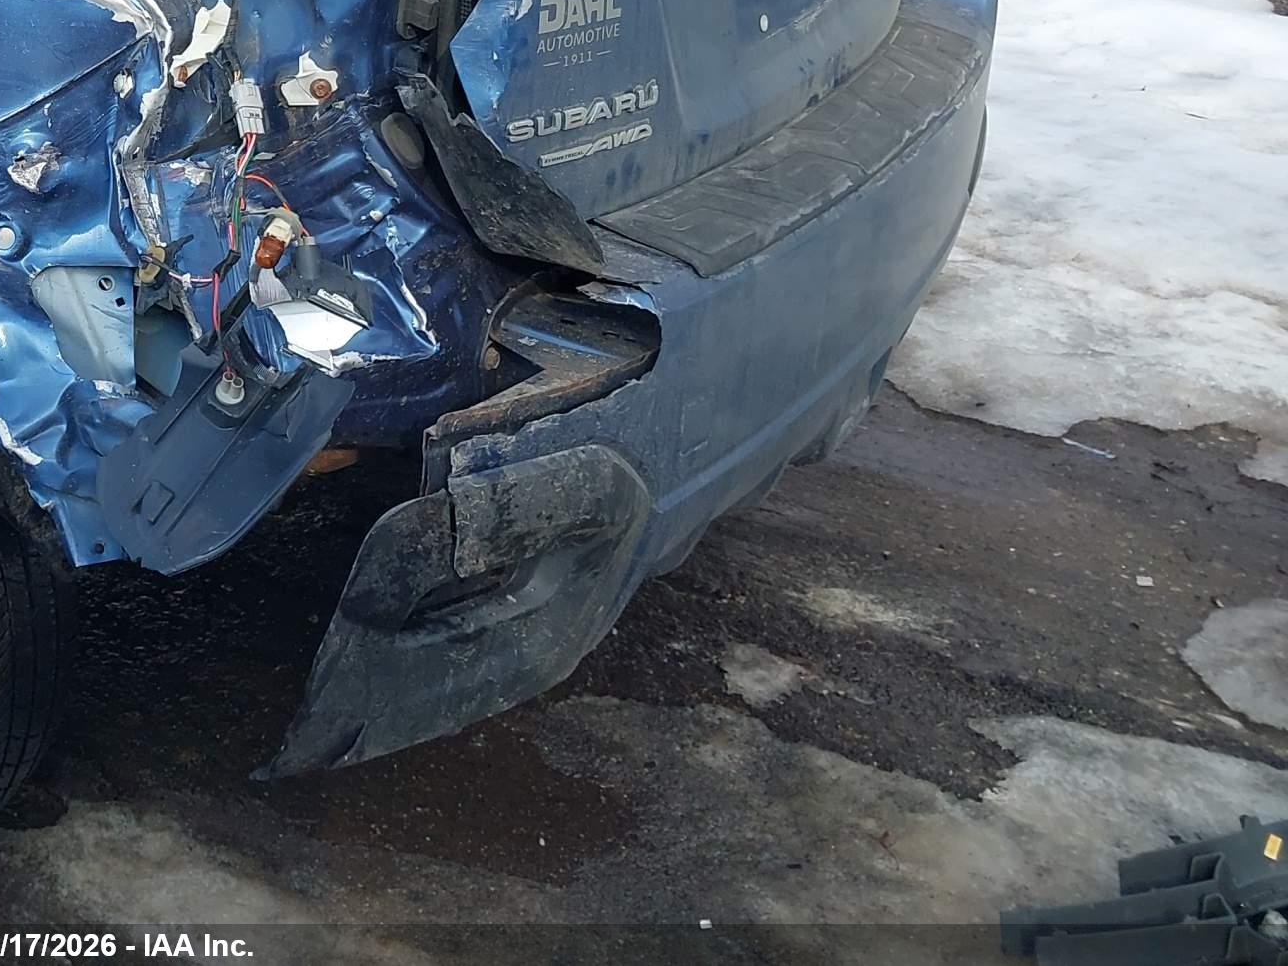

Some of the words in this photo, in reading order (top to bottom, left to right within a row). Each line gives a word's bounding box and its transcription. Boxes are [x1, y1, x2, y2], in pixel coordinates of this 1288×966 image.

[536, 23, 621, 54] AUTOMOTIVE
[562, 50, 593, 67] 1911
[508, 79, 659, 142] SUBARU
[585, 123, 654, 156] AWD
